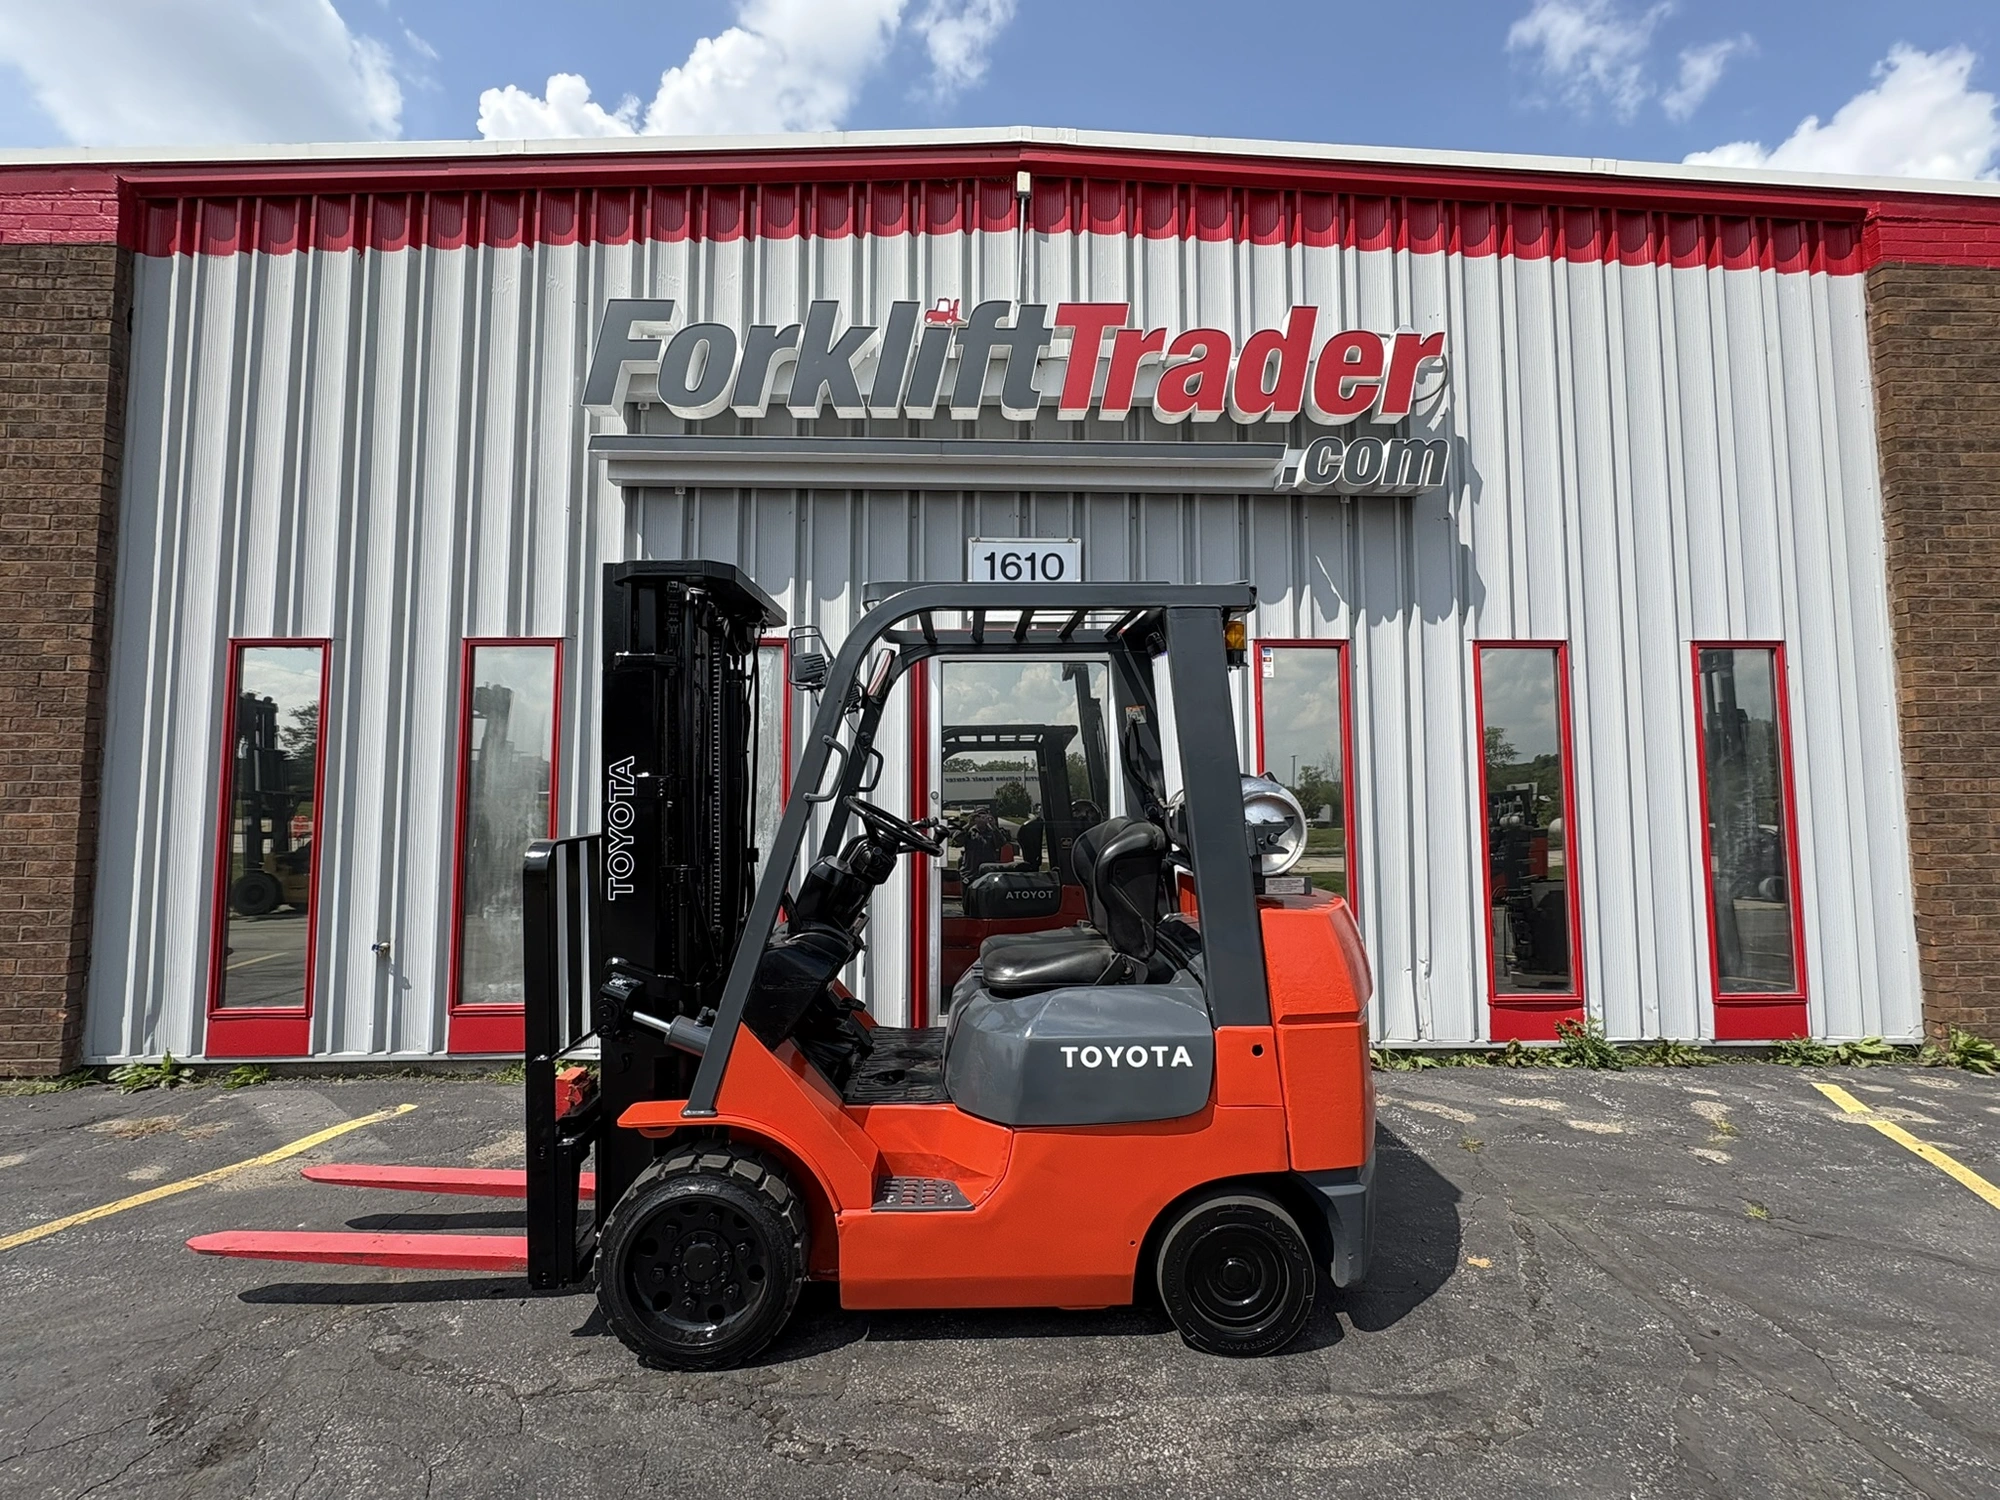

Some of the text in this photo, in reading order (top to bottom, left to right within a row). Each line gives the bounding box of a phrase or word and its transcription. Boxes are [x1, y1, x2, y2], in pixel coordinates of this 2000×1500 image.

[1279, 436, 1450, 488] .com
[983, 552, 1065, 581] 1610
[607, 755, 635, 901] TOYOTA
[1060, 1045, 1194, 1069] TOYOTA
